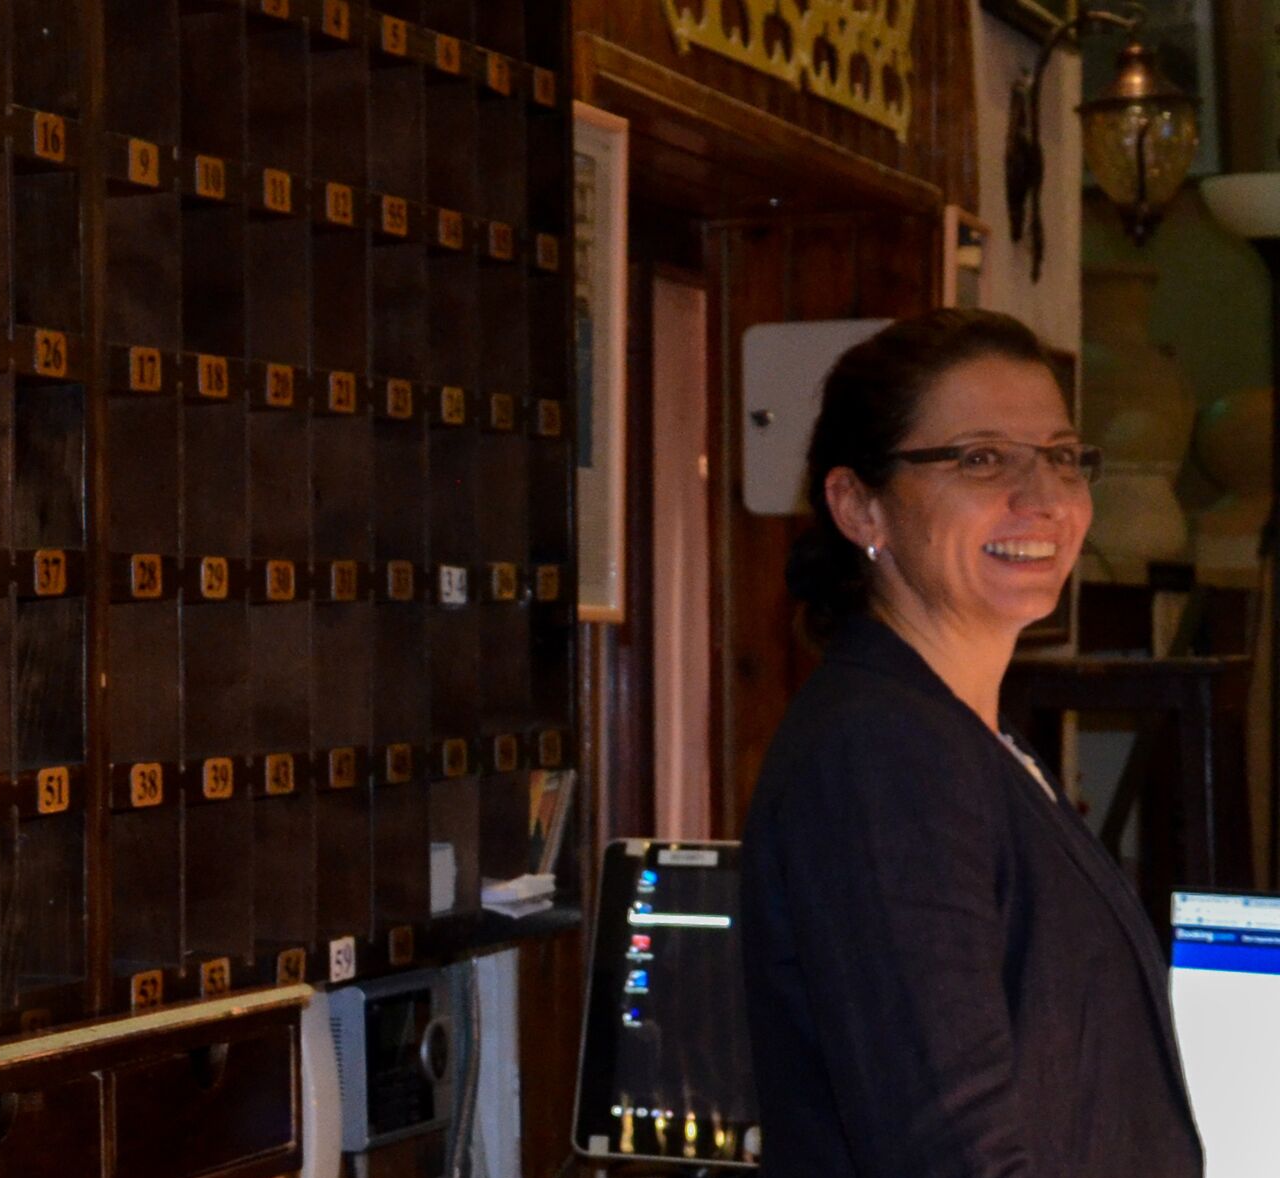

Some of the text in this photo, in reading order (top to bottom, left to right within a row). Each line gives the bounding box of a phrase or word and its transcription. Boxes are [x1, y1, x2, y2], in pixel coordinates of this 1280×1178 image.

[43, 122, 61, 153] 16
[139, 147, 150, 177] 9
[204, 163, 221, 192] 10
[43, 337, 62, 369] 26
[138, 355, 156, 385] 17
[207, 363, 223, 391] 18
[42, 557, 61, 587] 37
[45, 775, 63, 806] 51
[137, 769, 157, 800] 38
[210, 764, 228, 793] 39
[335, 943, 352, 978] 59
[140, 977, 158, 1009] 52
